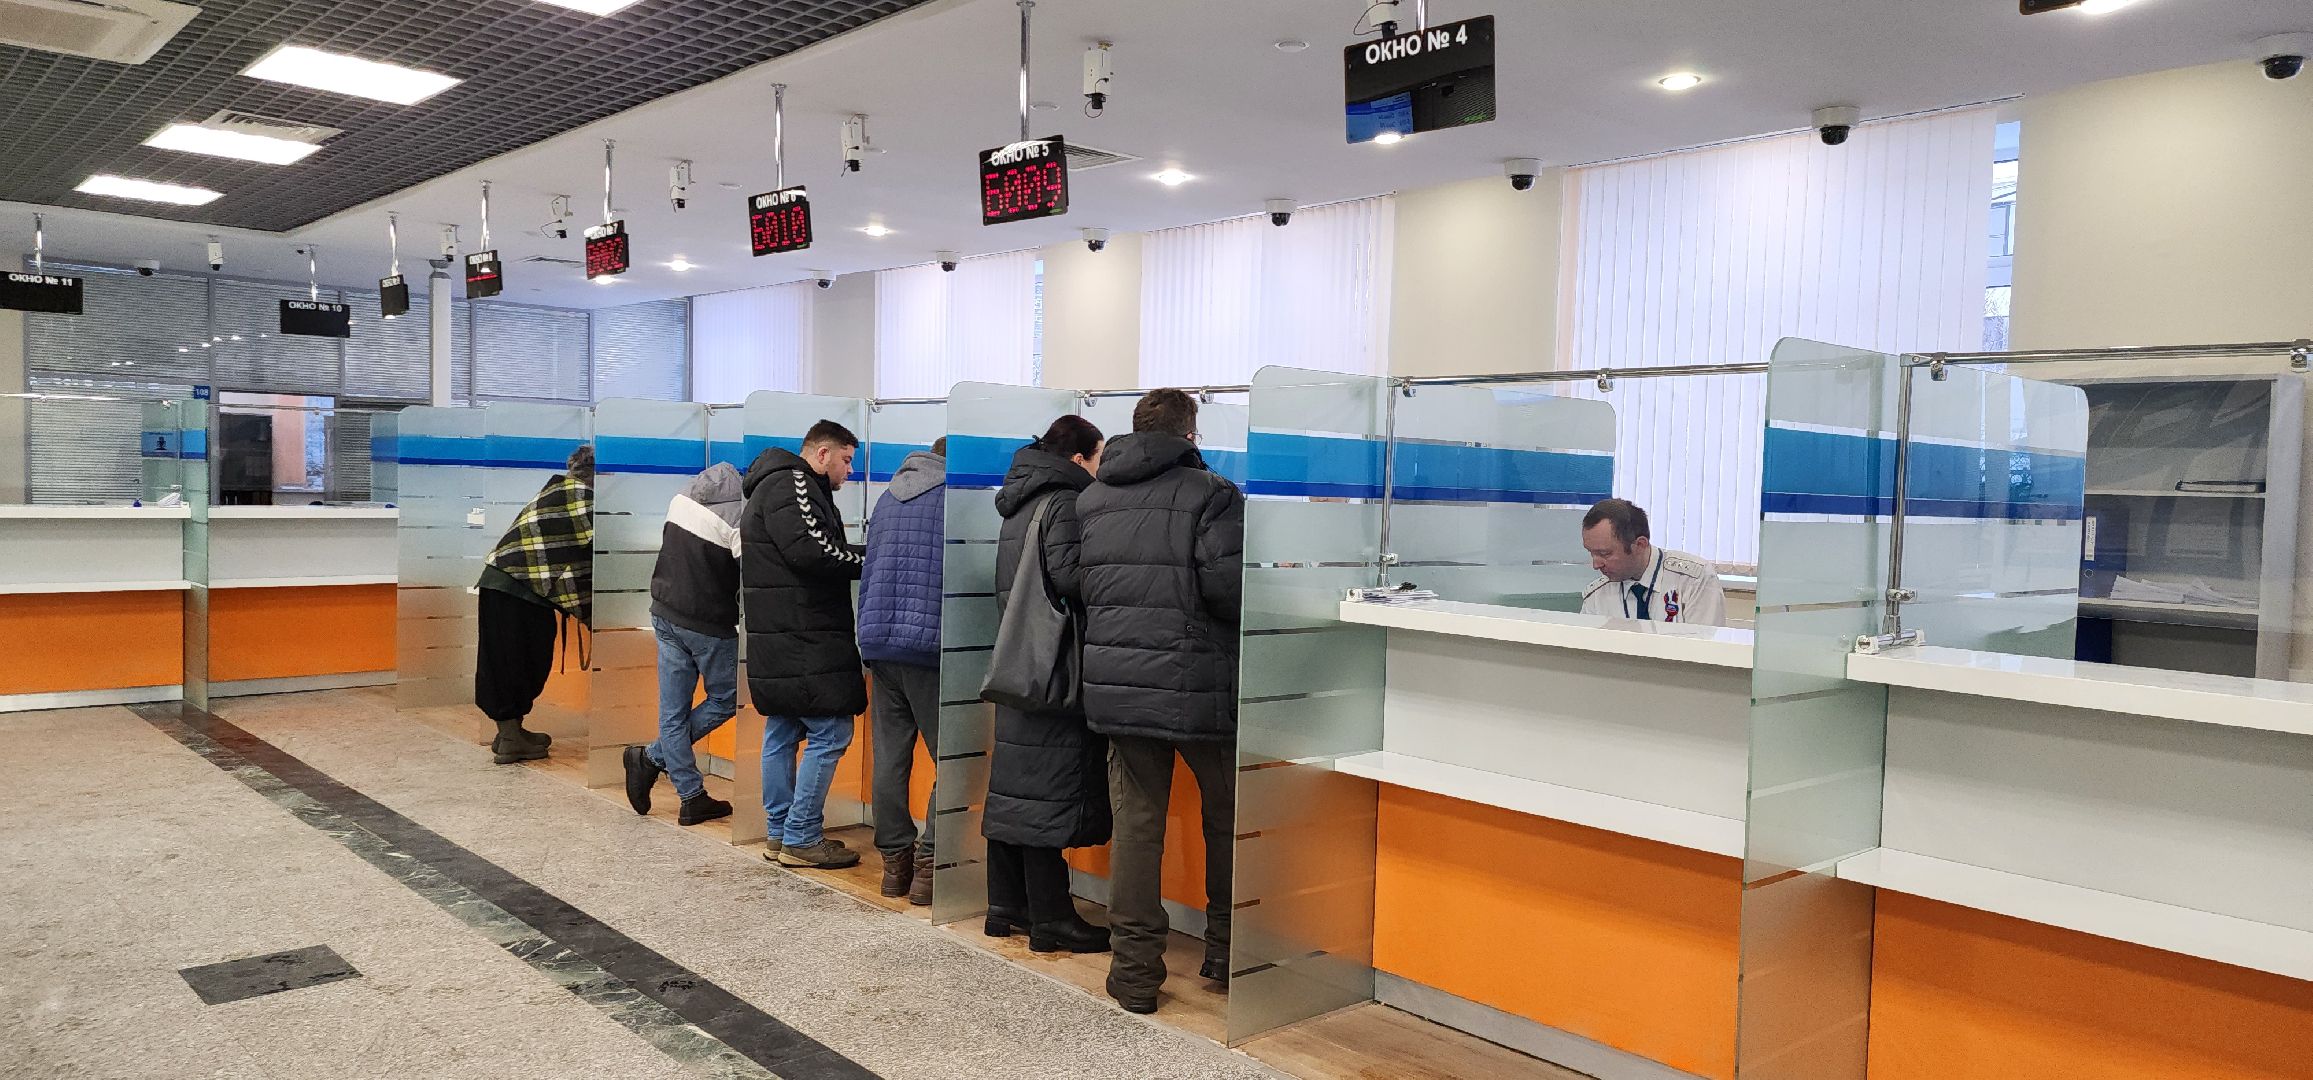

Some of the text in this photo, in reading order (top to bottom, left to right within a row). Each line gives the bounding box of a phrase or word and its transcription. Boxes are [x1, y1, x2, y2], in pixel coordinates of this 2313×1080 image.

[1365, 24, 1468, 64] ОКНО № 4
[991, 143, 1050, 166] ОКНО № 5
[755, 193, 779, 209] ОКНО
[780, 191, 789, 204] №
[8, 273, 73, 287] ОКНО № 11
[288, 301, 343, 313] ОКНО № 10
[196, 388, 209, 396] 108
